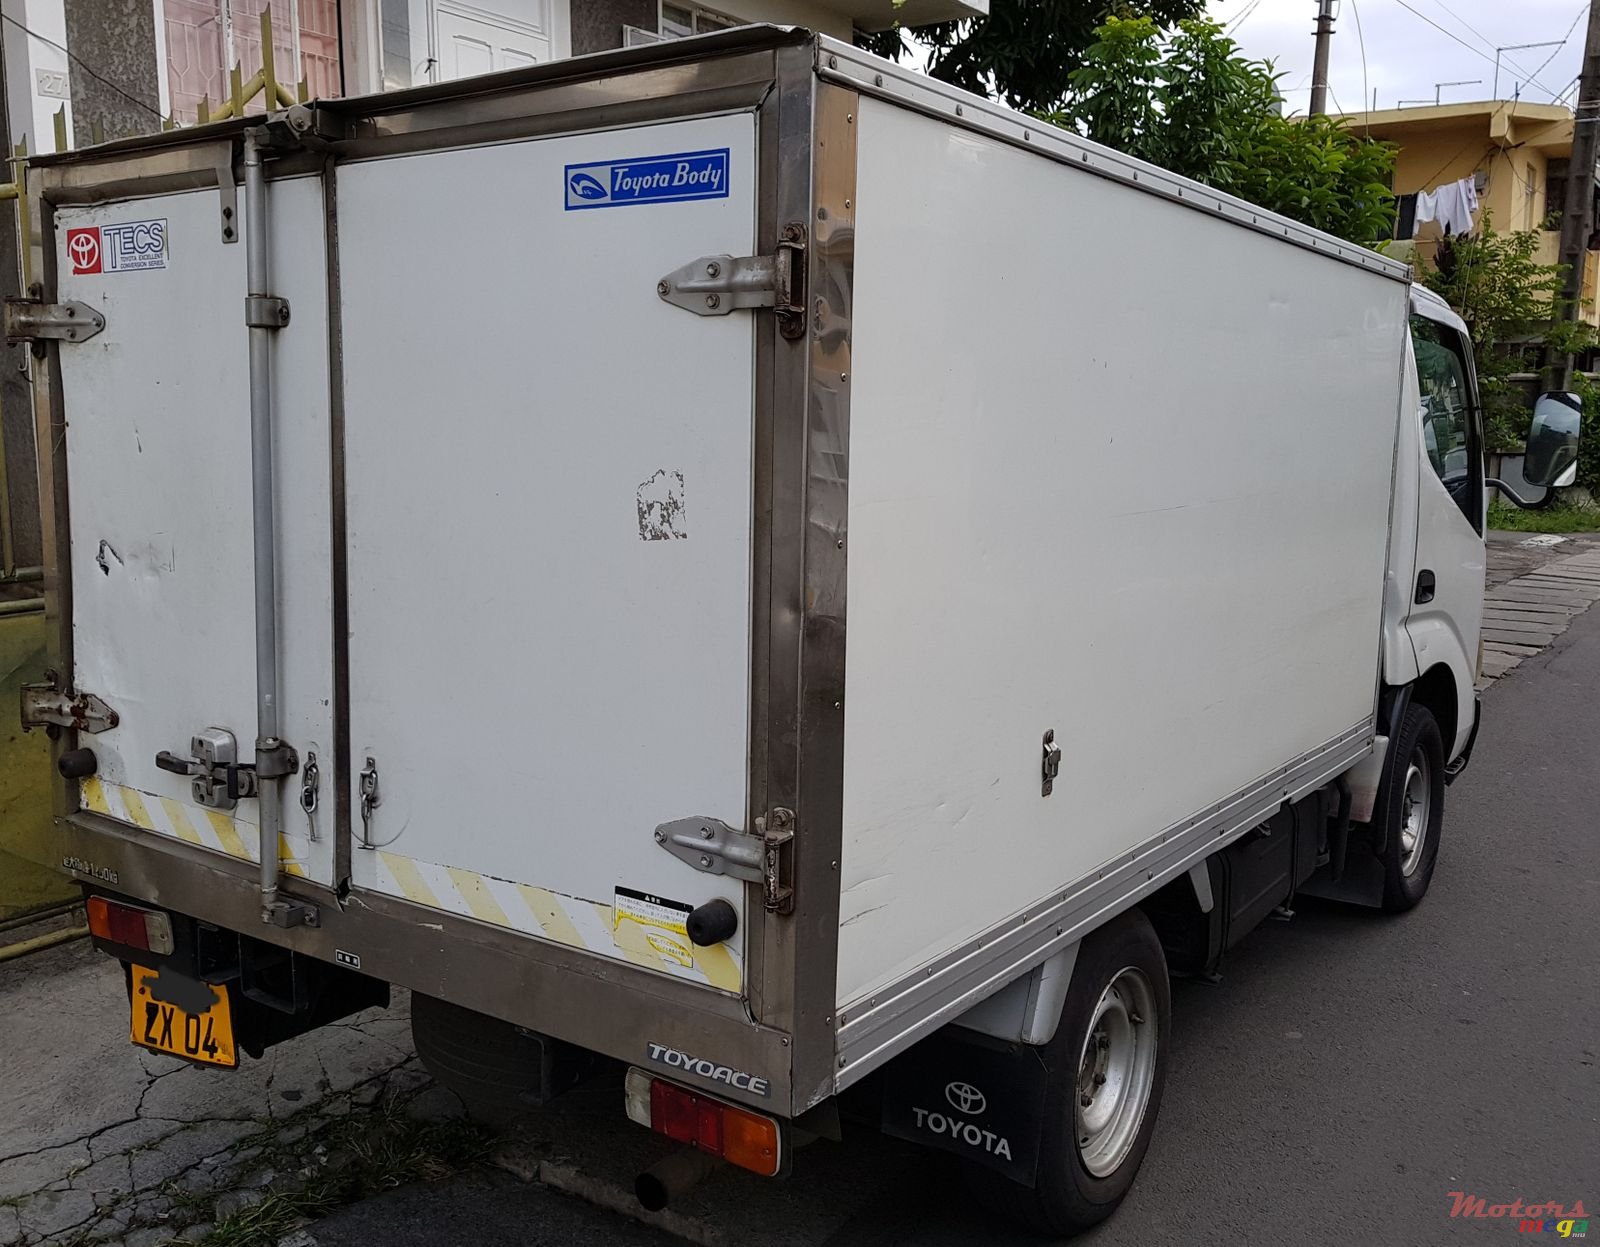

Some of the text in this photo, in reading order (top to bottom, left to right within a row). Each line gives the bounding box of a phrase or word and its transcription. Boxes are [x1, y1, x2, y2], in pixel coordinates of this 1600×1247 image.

[41, 74, 64, 95] 27
[614, 162, 722, 196] Toyota Body
[103, 223, 164, 269] TECS
[120, 253, 163, 263] TOYOTA EXCELLENT
[144, 1001, 219, 1059] ZX 04
[649, 1042, 768, 1096] TOYOACE
[912, 1106, 1012, 1161] TOYOTA
